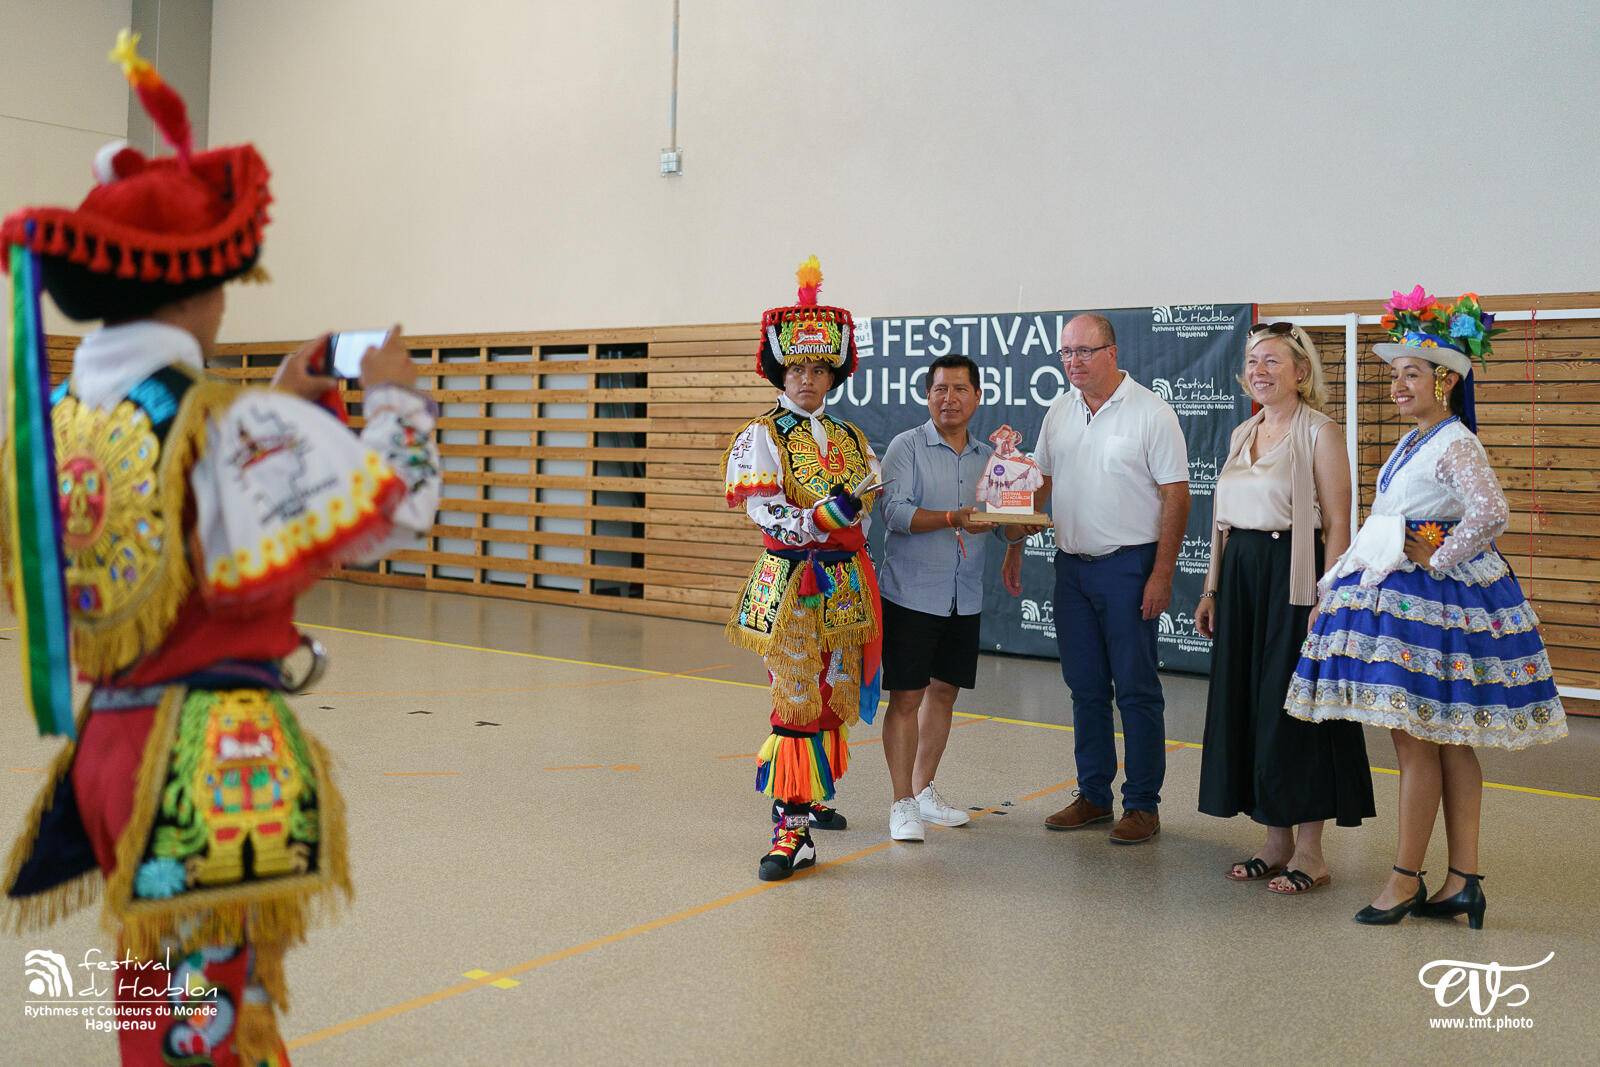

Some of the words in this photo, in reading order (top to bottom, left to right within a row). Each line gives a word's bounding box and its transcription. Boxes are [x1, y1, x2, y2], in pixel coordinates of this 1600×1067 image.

[1174, 311, 1188, 323] du
[1190, 310, 1235, 322] Houblon
[1152, 325, 1175, 333] Rythmes
[1174, 377, 1214, 389] festival
[1174, 388, 1188, 401] du
[1190, 388, 1235, 401] Houblon
[1177, 409, 1208, 417] Haguenau
[1187, 456, 1217, 469] estival
[1180, 566, 1209, 575] Haguena
